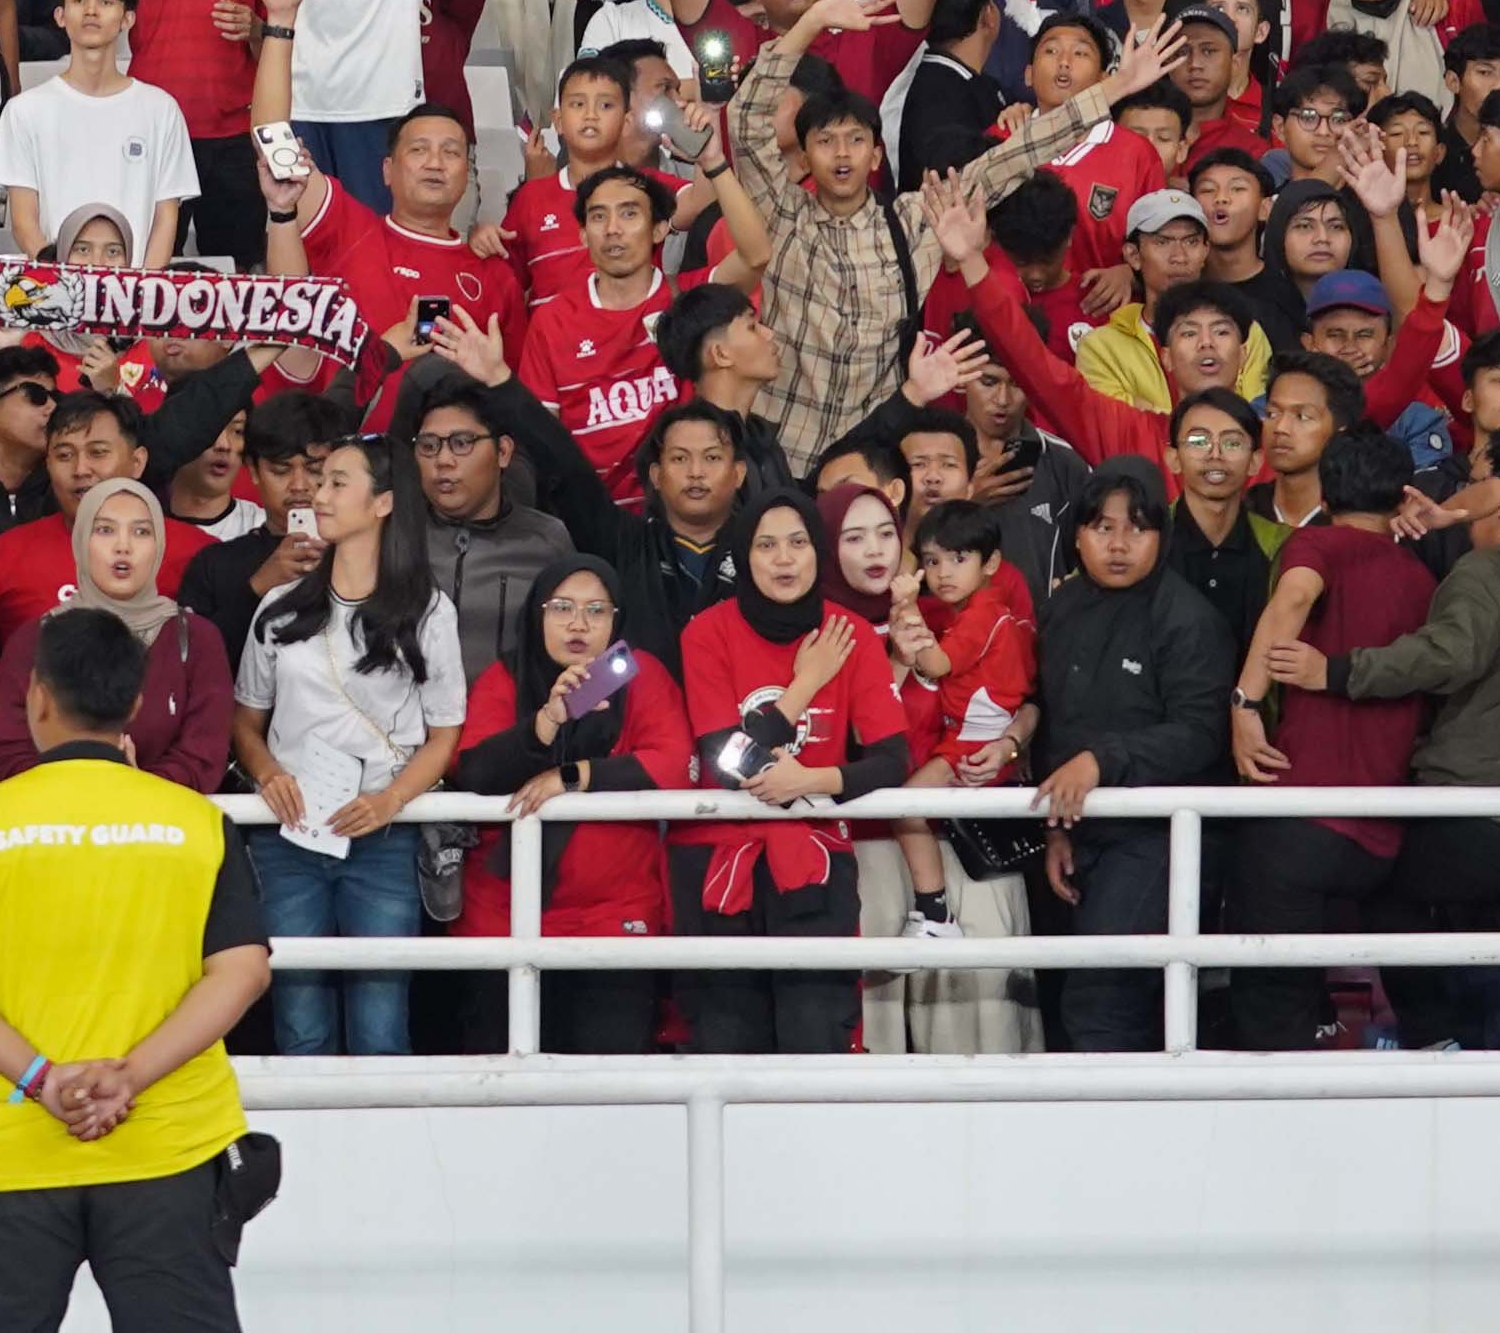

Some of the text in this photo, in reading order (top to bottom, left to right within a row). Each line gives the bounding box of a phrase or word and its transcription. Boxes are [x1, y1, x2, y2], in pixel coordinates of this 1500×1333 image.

[82, 273, 359, 349] INDONESIA
[586, 366, 679, 429] AQUA
[90, 823, 186, 849] GUARD
